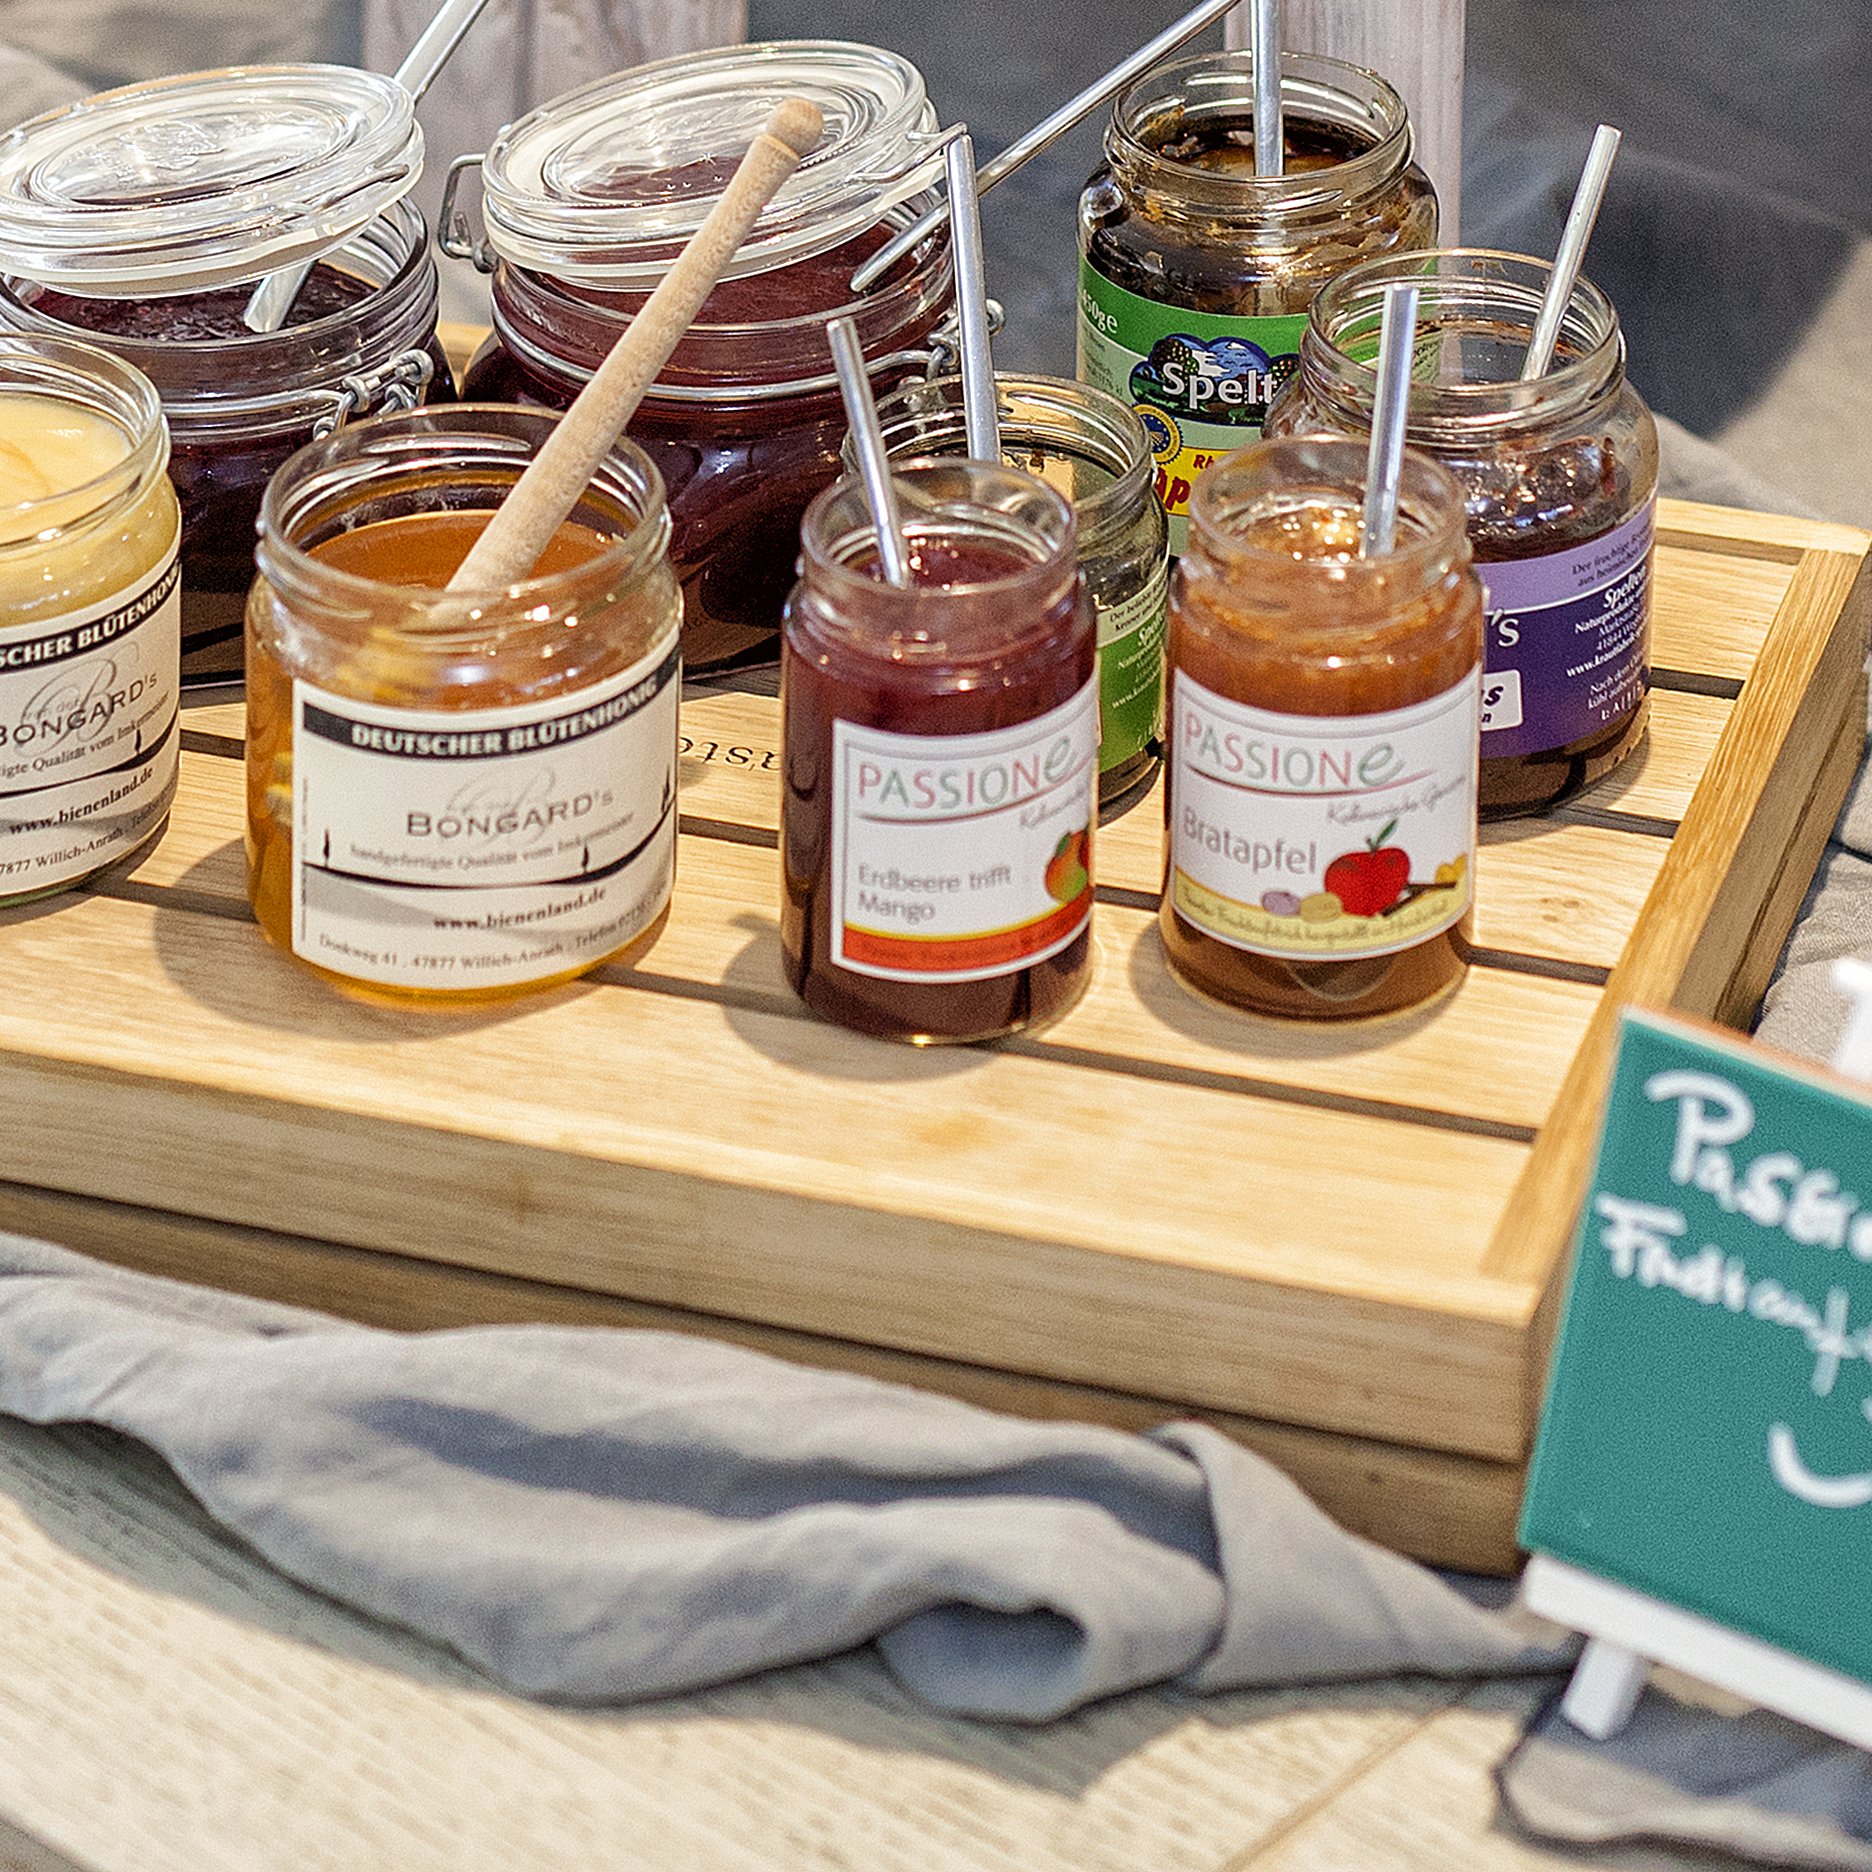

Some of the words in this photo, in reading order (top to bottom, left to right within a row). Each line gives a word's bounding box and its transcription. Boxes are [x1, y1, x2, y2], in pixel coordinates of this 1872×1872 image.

[351, 722, 503, 756] DEUTSCHER
[508, 676, 658, 752] BLÜTENHONIG
[32, 745, 86, 772] Qualität
[89, 734, 115, 753] vom
[8, 765, 153, 835] www.bienenland.de
[1182, 806, 1317, 875] Bratapfel
[857, 862, 961, 895] Erdbeere
[968, 864, 1013, 891] trifft
[434, 887, 608, 930] www.bienenland.de
[856, 892, 936, 926] Mango
